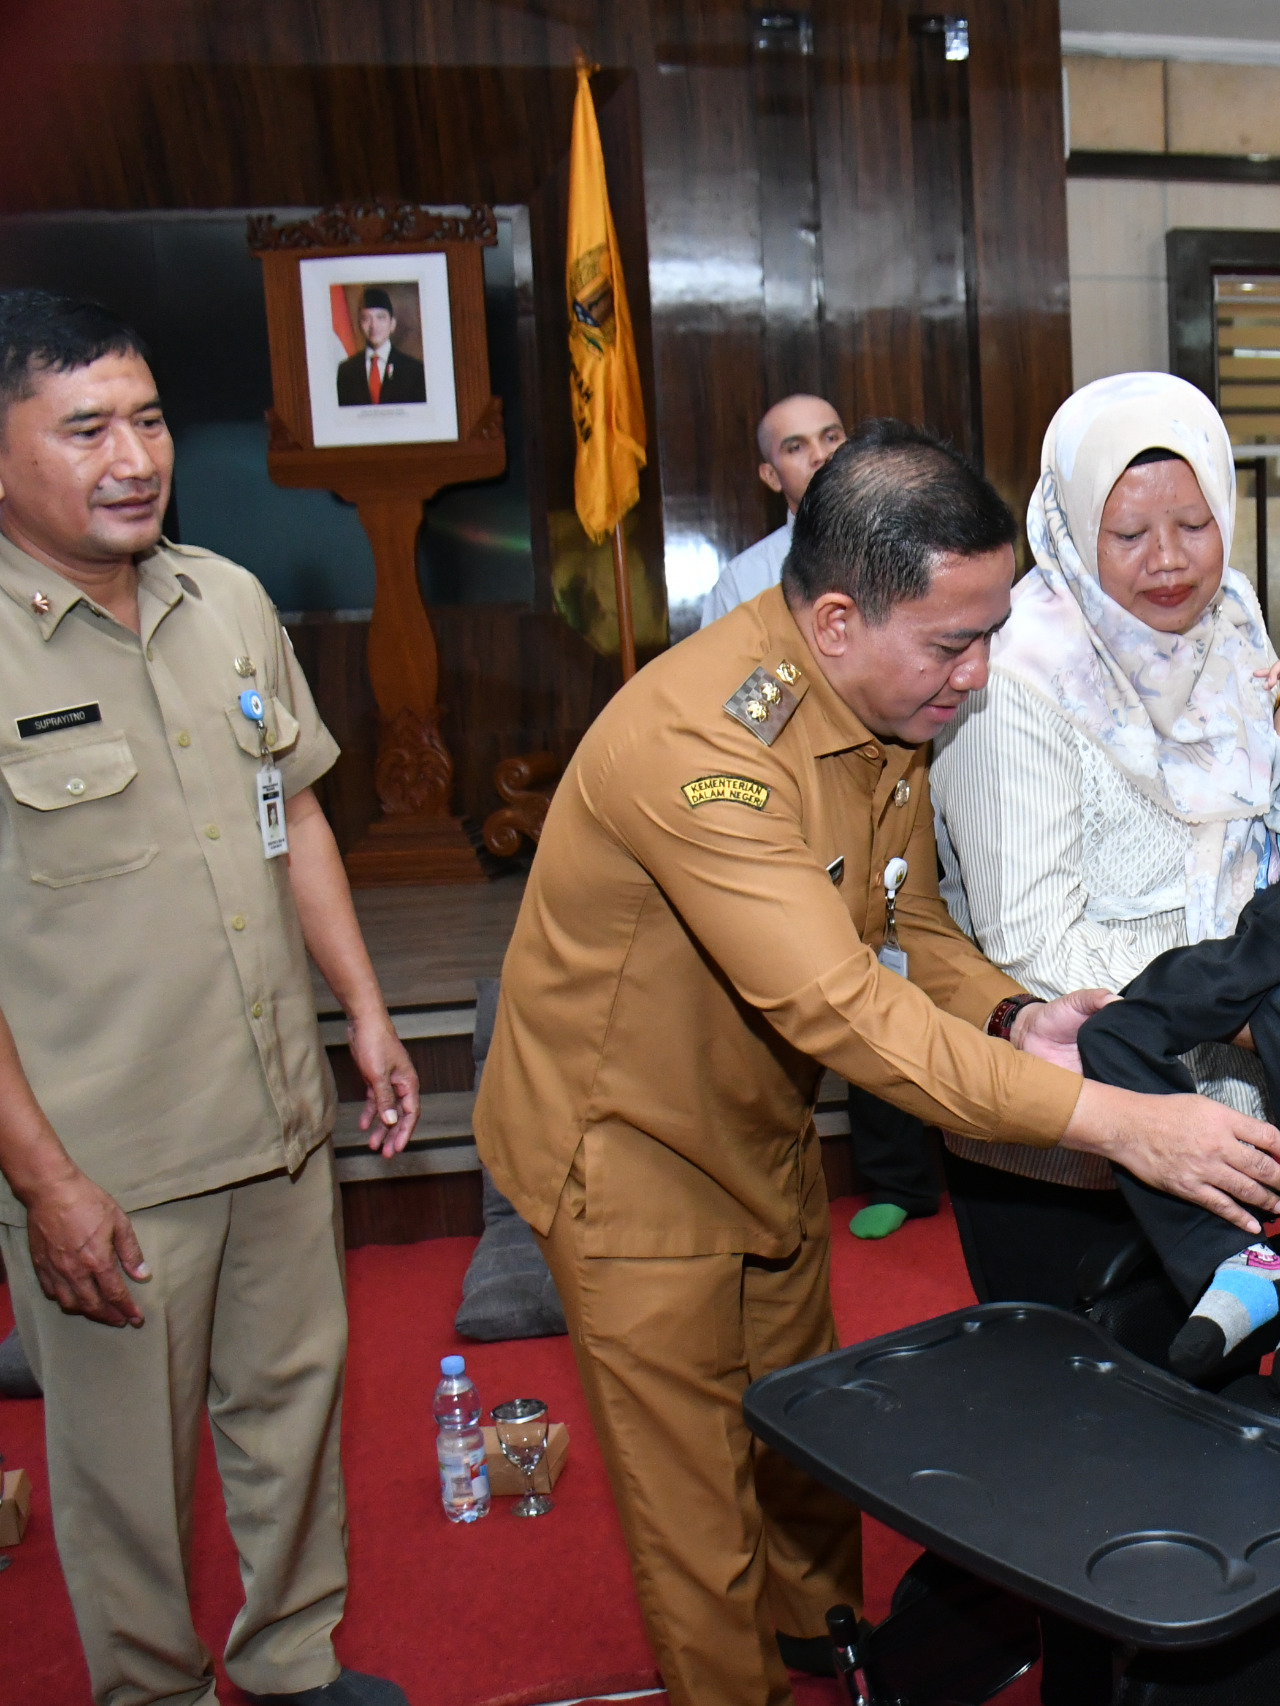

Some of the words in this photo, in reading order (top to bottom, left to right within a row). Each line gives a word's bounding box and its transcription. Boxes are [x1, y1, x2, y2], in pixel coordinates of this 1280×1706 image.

[34, 711, 86, 730] SUPRAYITNO
[691, 779, 762, 795] KEMENTERIAN
[691, 789, 725, 804] DALAM
[729, 791, 764, 805] NEGERI
